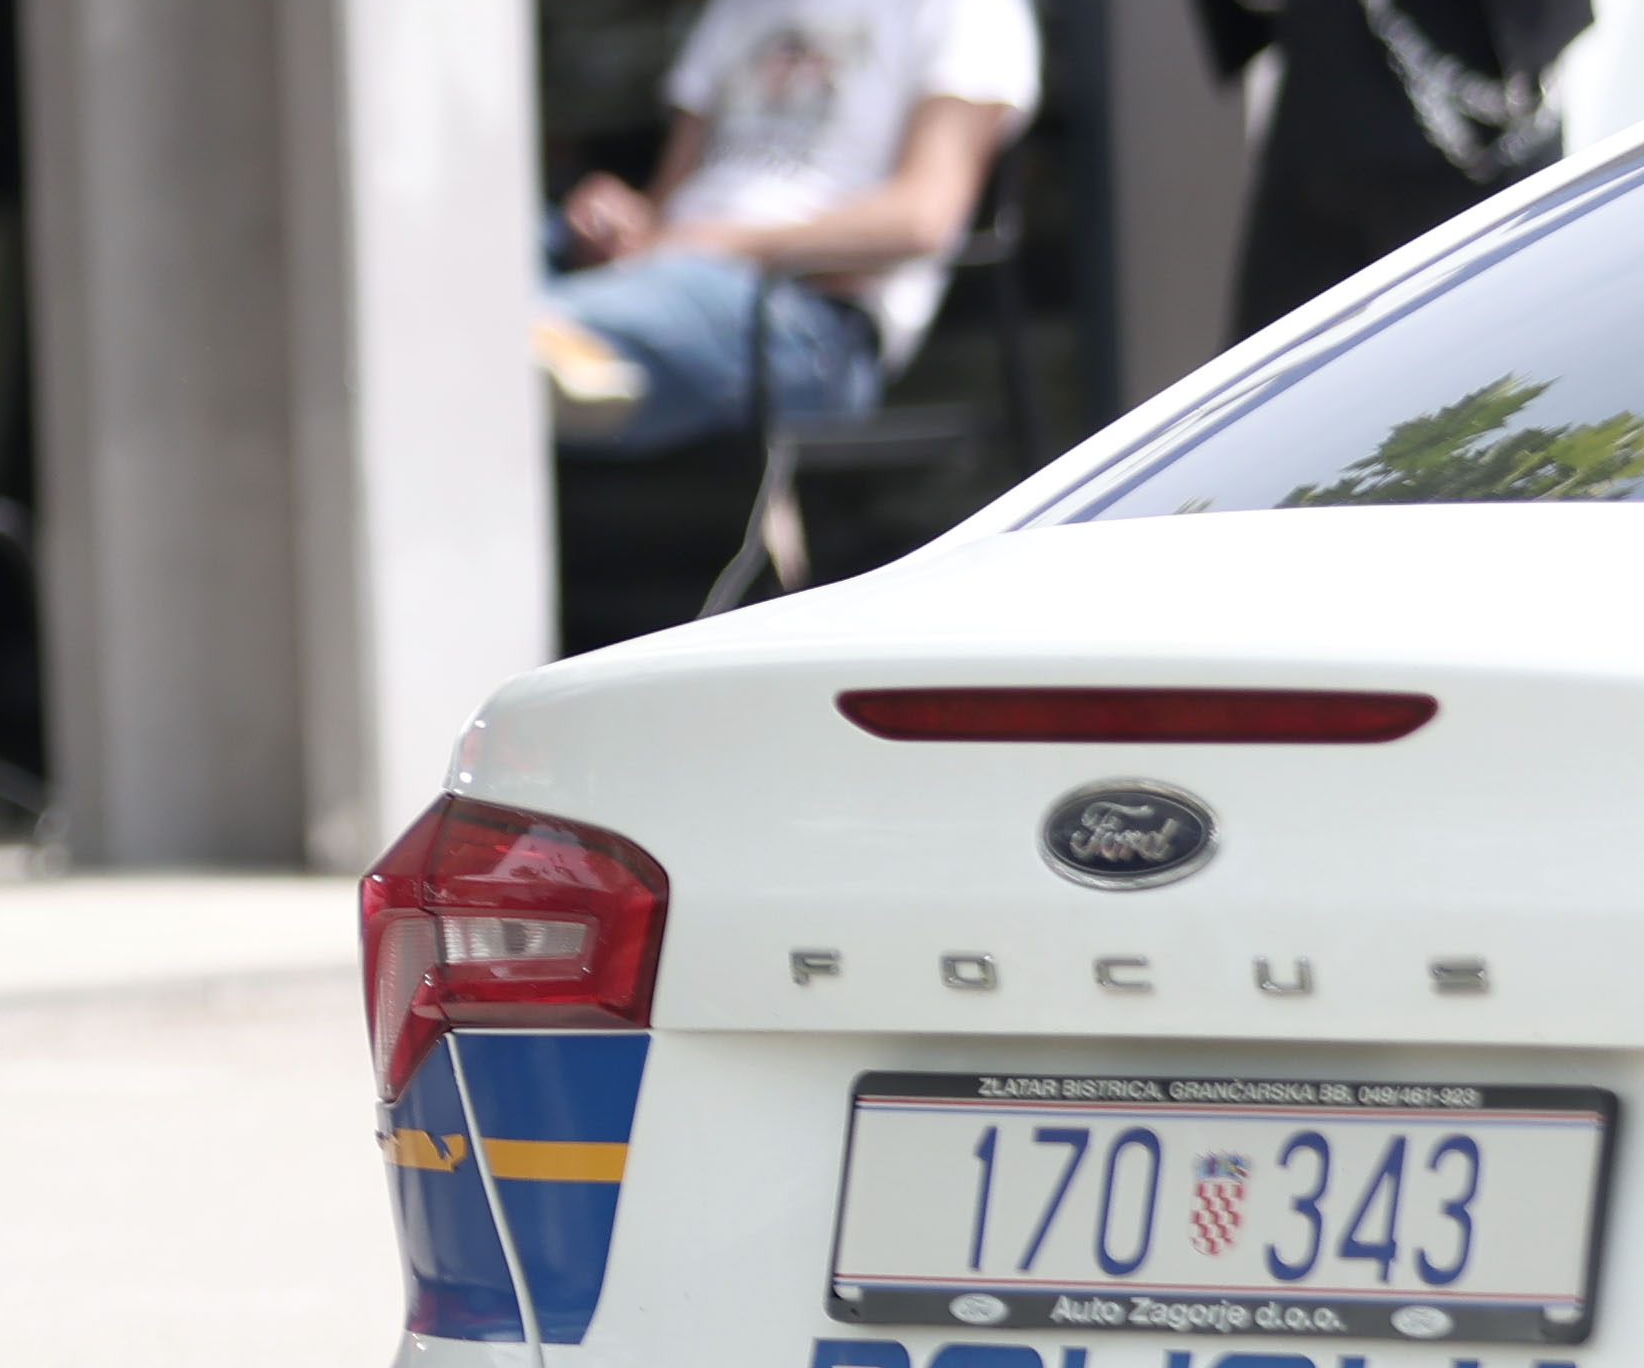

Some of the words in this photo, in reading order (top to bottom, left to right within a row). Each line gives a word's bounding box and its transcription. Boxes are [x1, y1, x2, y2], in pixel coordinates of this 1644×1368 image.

[1069, 800, 1184, 862] Ford
[789, 948, 1492, 995] FOCUS
[978, 1076, 1057, 1098] ZLATAR
[969, 1125, 1162, 1277] 170
[1263, 1130, 1480, 1286] 343
[1049, 1294, 1123, 1325] Auto
[1128, 1296, 1247, 1332] Zagorje
[1254, 1303, 1346, 1330] d.o.o.
